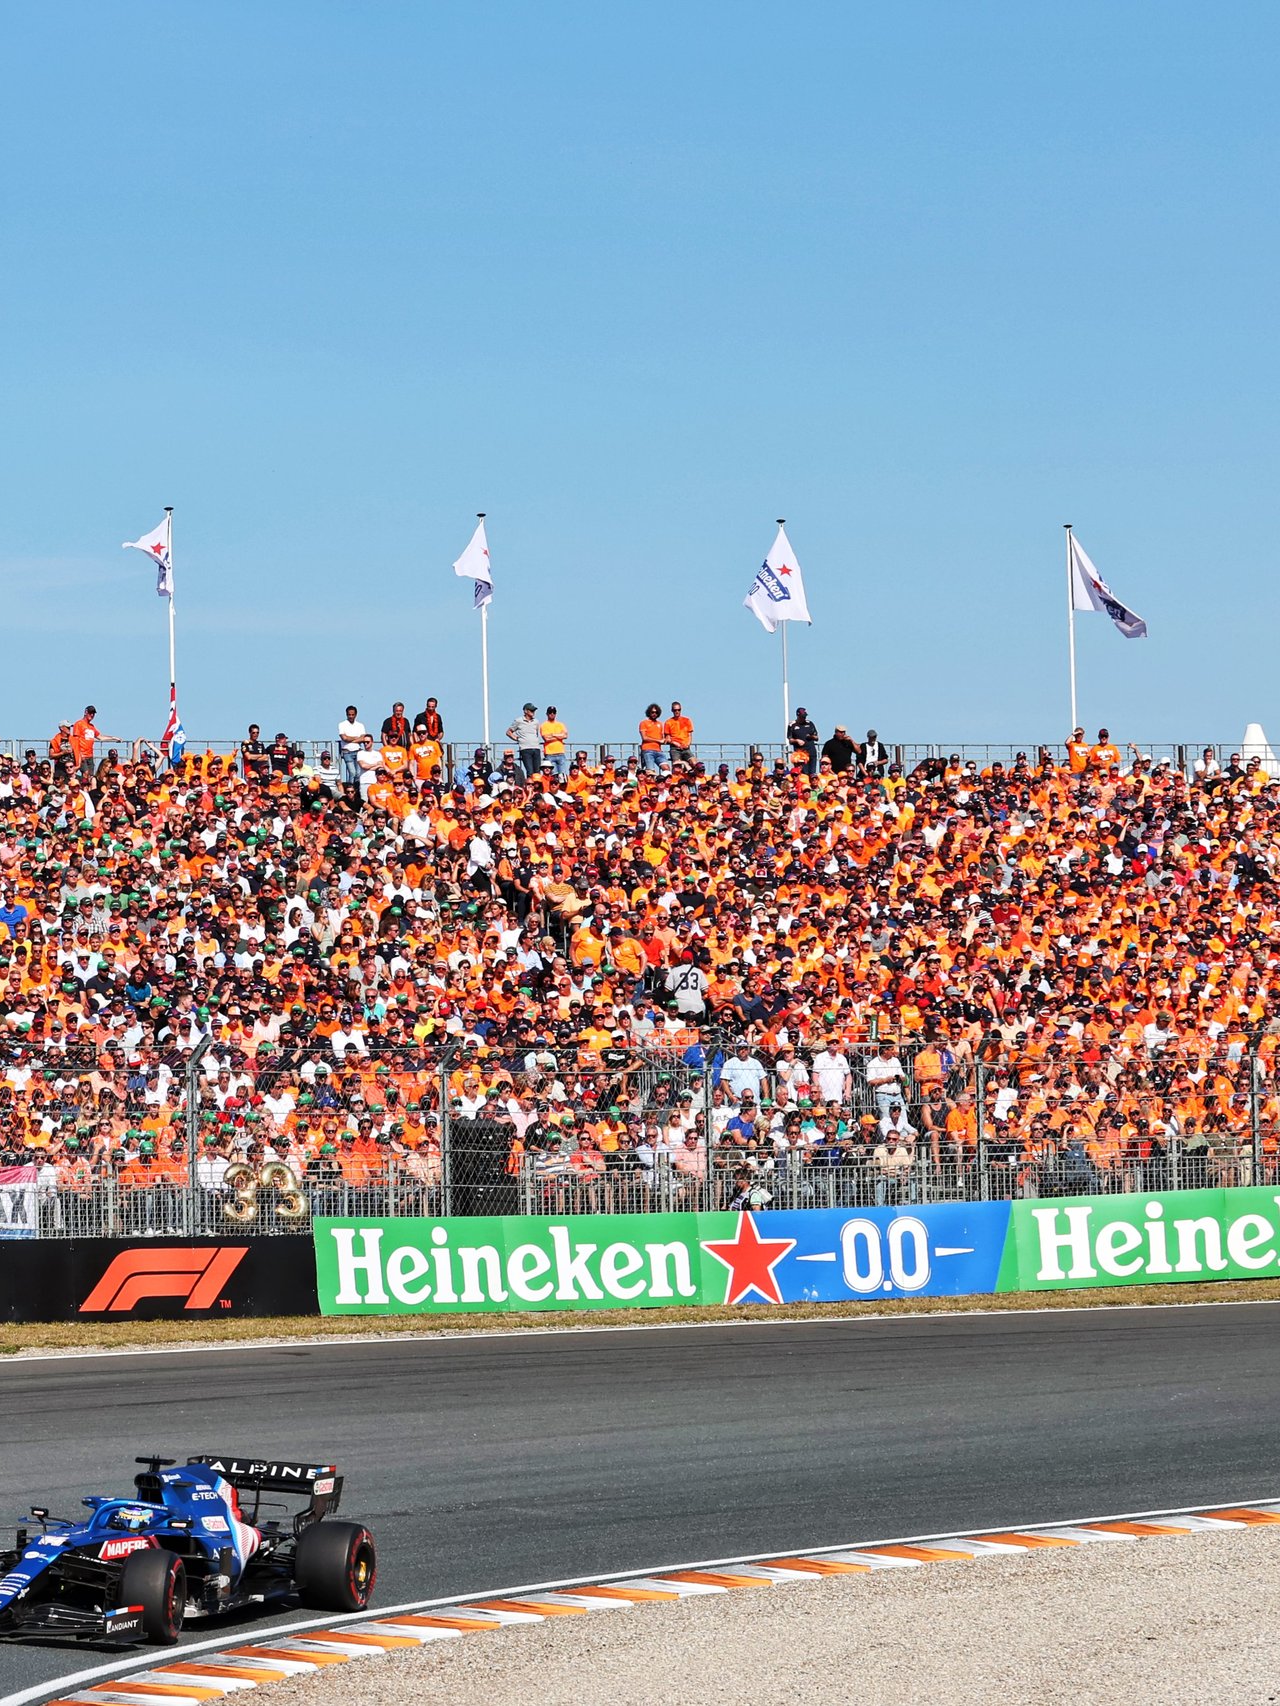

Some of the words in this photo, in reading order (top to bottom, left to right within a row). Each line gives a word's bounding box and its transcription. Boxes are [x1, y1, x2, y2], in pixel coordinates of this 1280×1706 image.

[758, 566, 786, 600] ineken
[679, 972, 699, 990] 33
[222, 1161, 311, 1222] 33
[330, 1226, 697, 1306] Heineken
[840, 1216, 933, 1293] 0.0
[1031, 1200, 1280, 1281] Heine
[78, 1247, 249, 1312] F1
[191, 1491, 219, 1501] E-TECH
[209, 1460, 318, 1480] ALPINE
